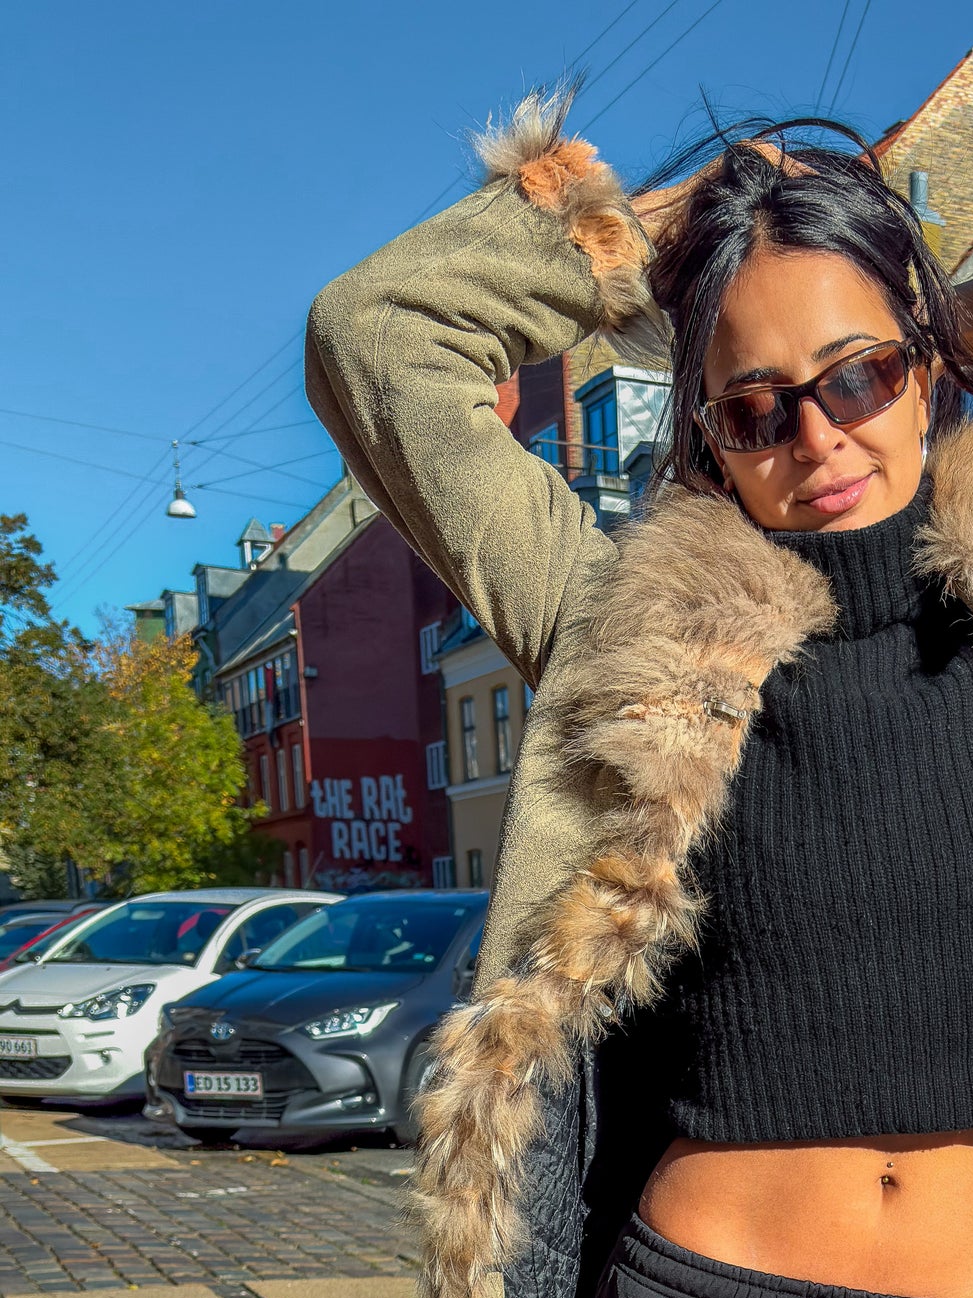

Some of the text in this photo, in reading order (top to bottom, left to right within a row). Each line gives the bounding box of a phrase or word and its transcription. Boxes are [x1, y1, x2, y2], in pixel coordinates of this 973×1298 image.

[331, 820, 403, 862] RACE
[194, 1076, 259, 1092] ED 15 133
